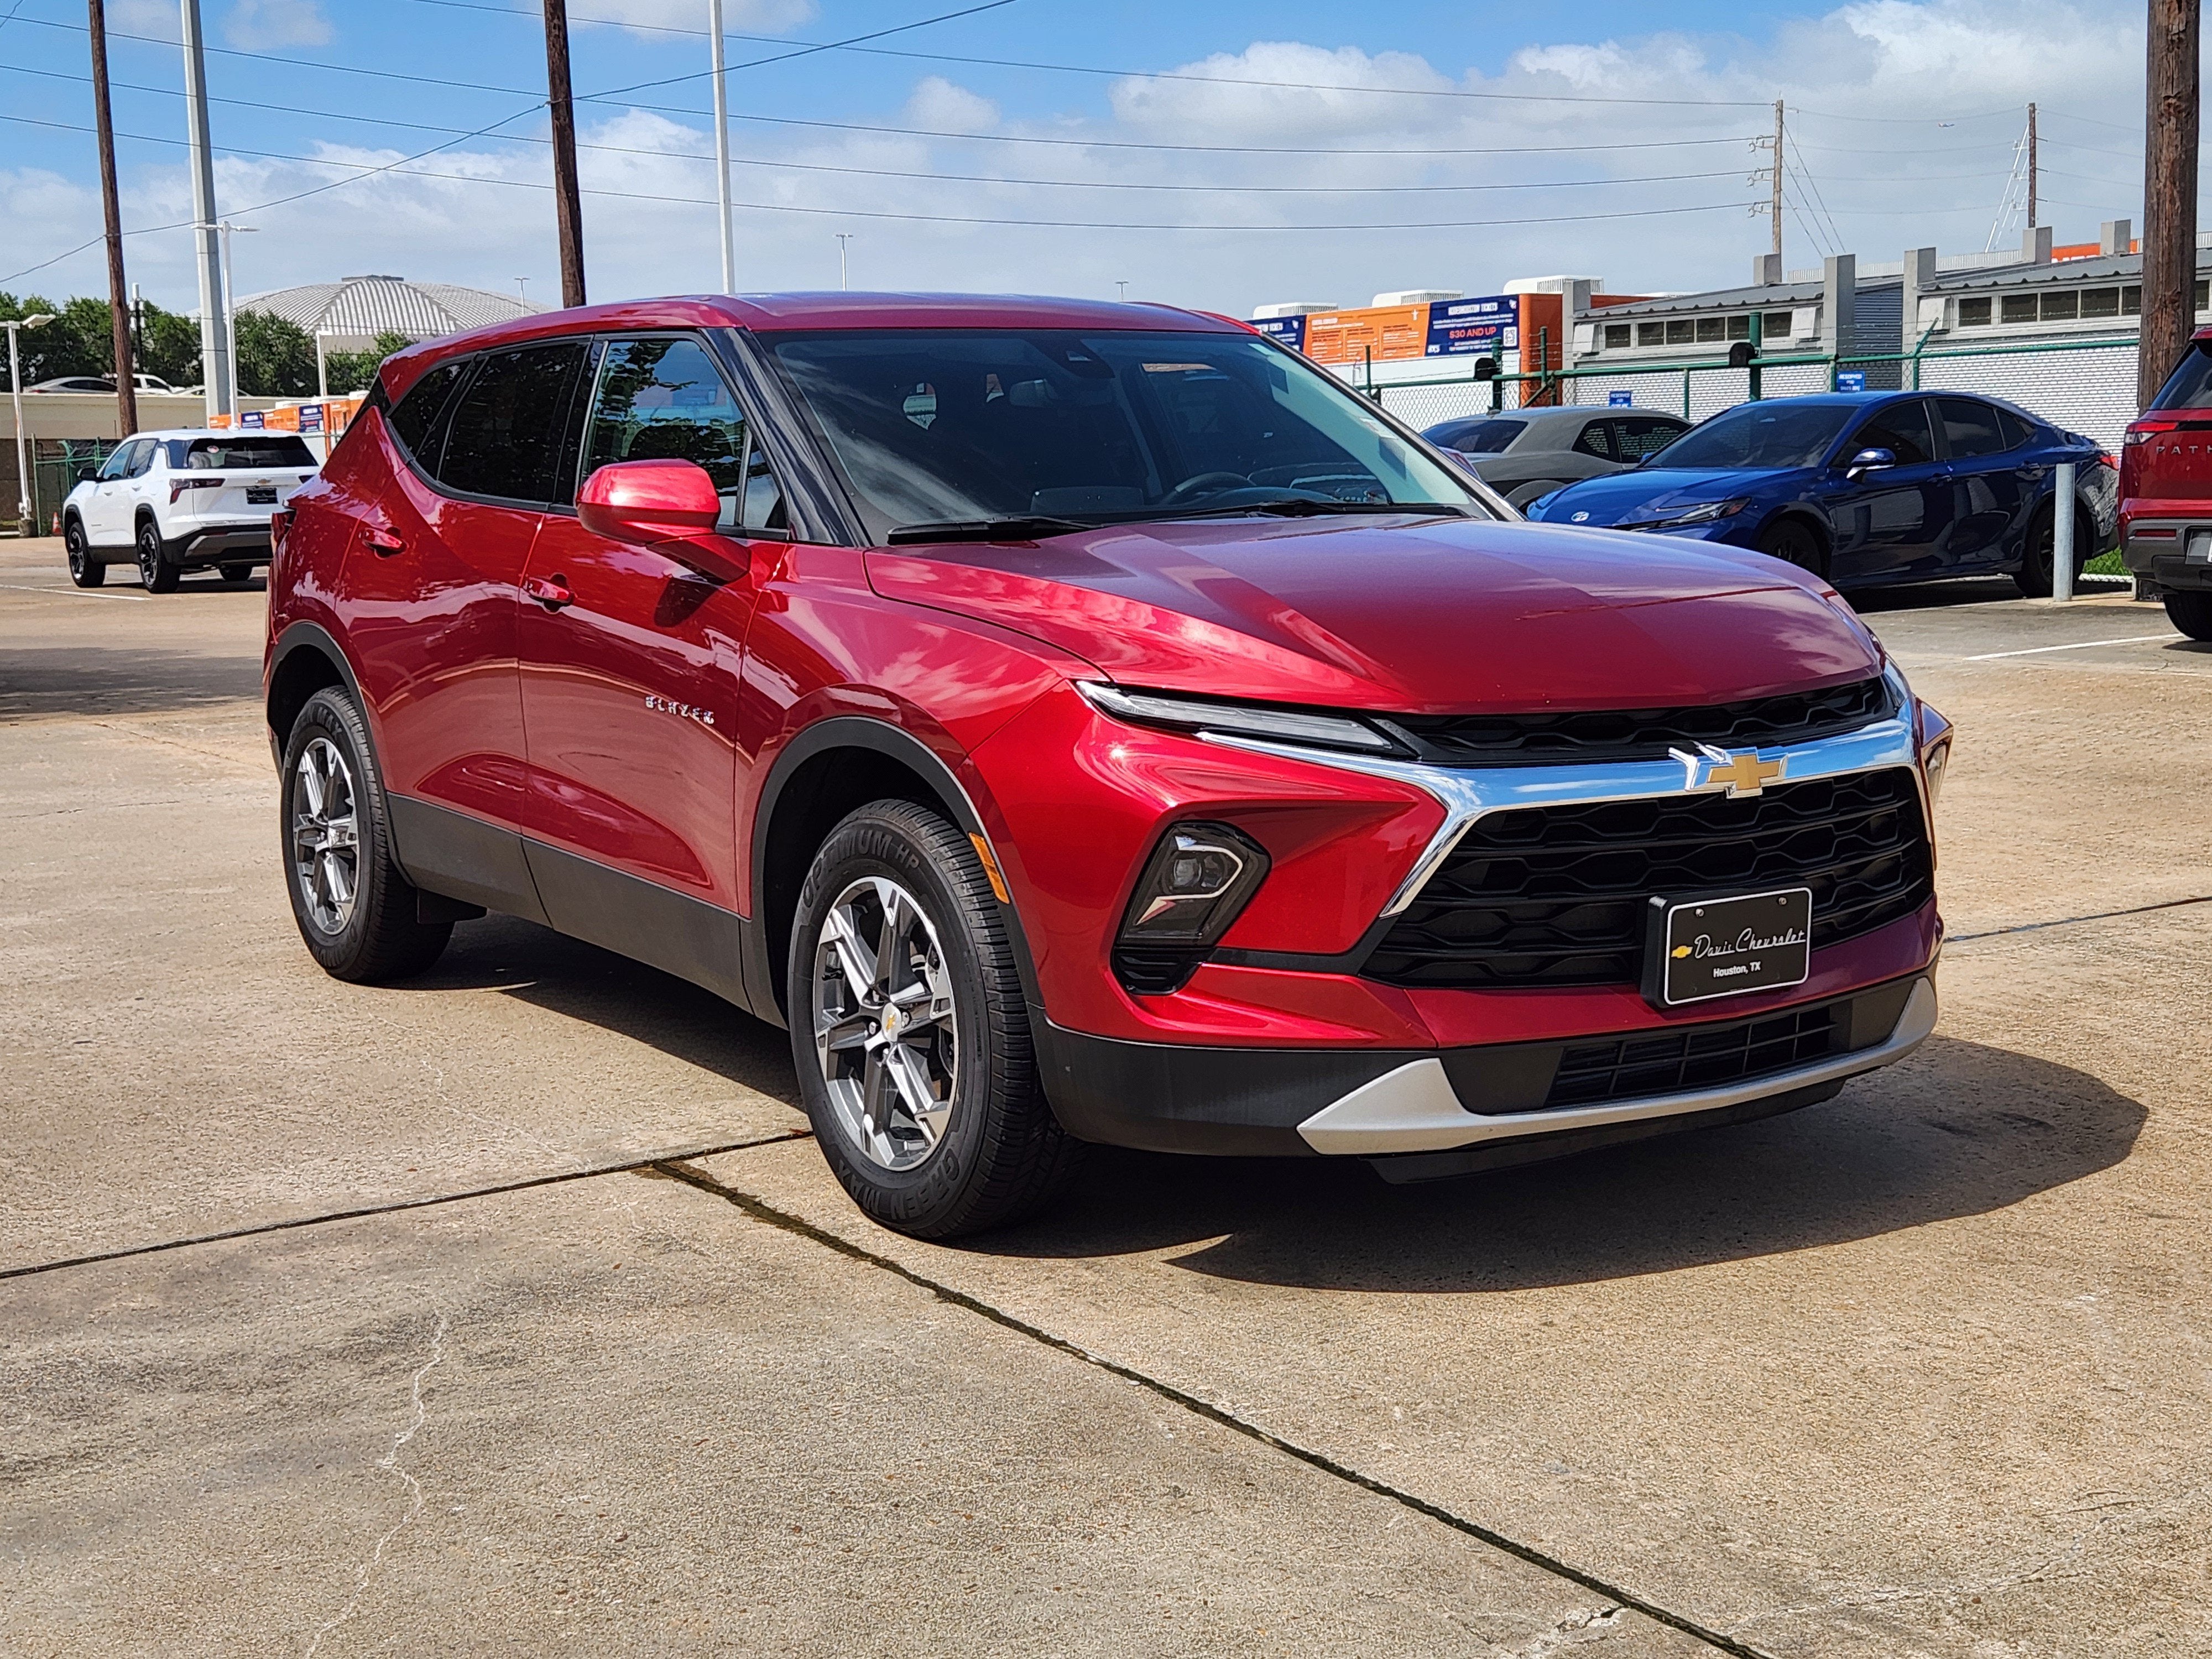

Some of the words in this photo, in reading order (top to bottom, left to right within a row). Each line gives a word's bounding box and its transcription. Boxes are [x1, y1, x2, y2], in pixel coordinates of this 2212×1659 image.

[1466, 327, 1484, 337] AND
[1485, 326, 1497, 336] UP
[645, 695, 714, 724] BLAZER
[803, 828, 894, 908] OPTIMUM
[895, 843, 920, 869] HP
[1694, 933, 1735, 959] Davis
[1735, 927, 1806, 952] Chevrolet
[1713, 965, 1749, 978] Houston,
[1749, 961, 1761, 972] TX
